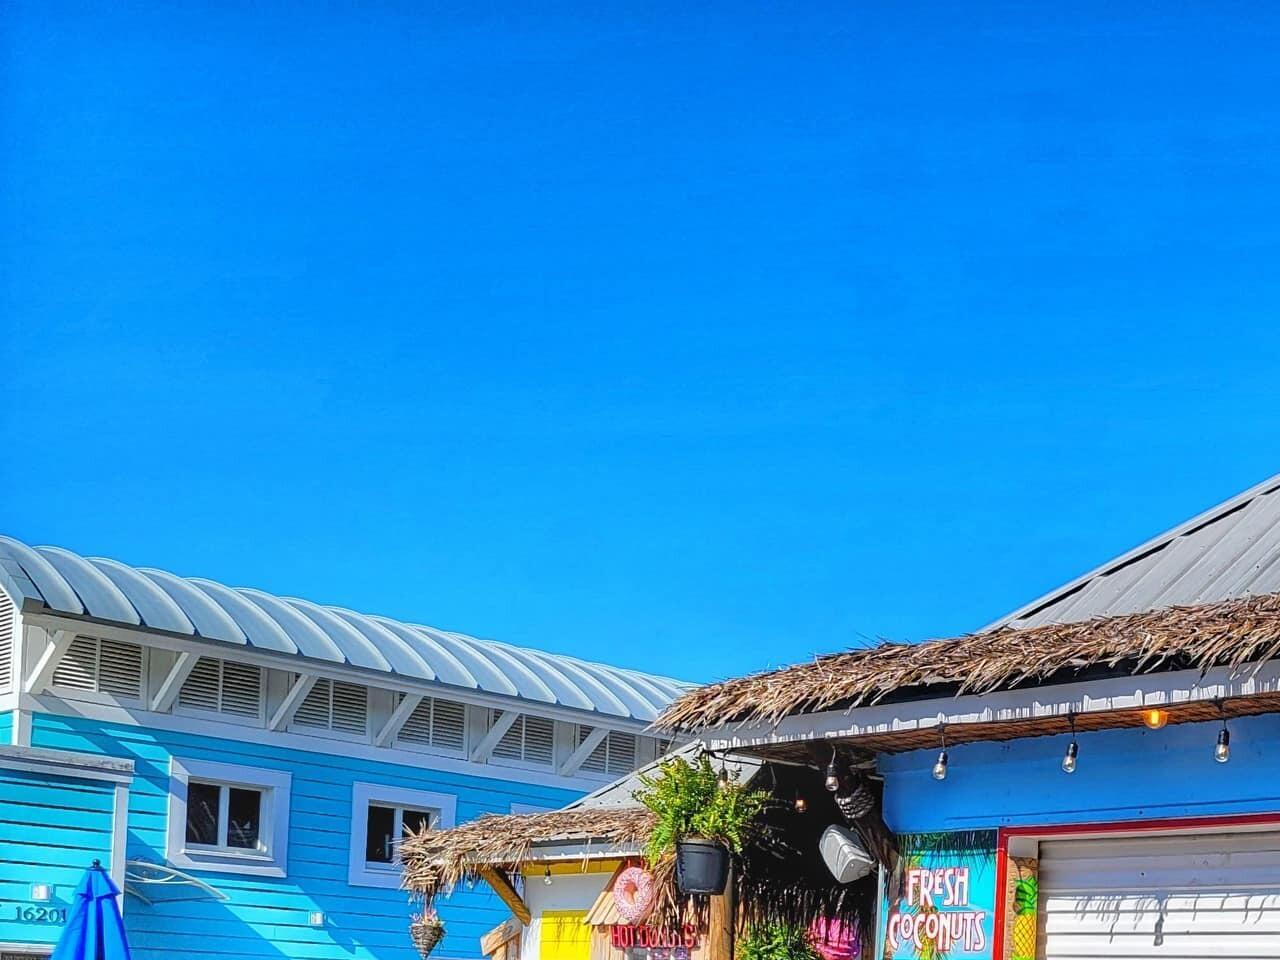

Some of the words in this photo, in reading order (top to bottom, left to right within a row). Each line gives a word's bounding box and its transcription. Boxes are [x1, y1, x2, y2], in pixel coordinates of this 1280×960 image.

[907, 867, 970, 906] FRESH
[16, 906, 67, 922] 16201
[612, 925, 634, 947] HOT
[888, 912, 986, 951] COCONUTS
